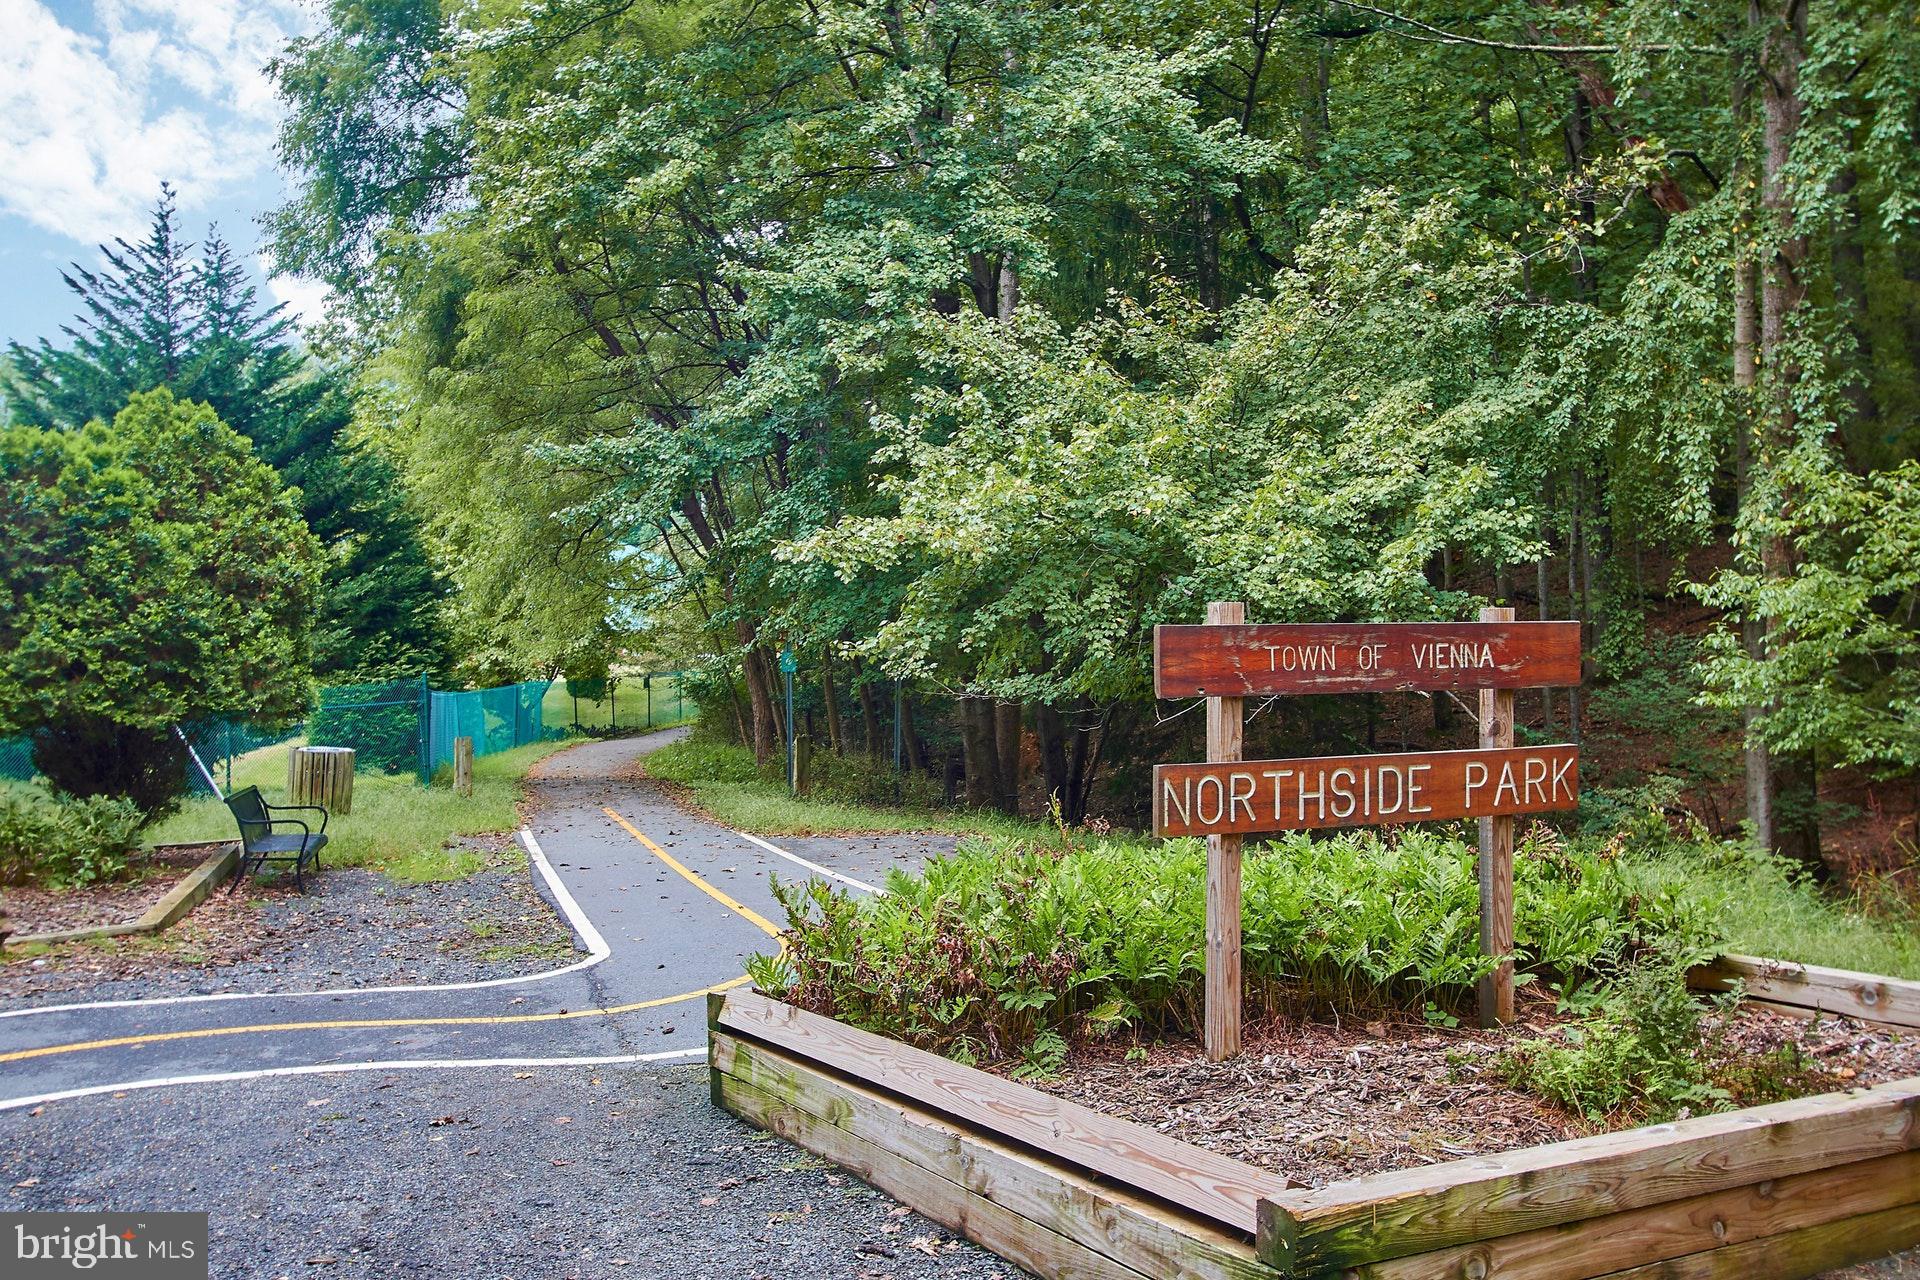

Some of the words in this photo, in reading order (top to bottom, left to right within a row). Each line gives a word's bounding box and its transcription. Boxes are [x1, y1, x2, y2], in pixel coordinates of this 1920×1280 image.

[1264, 645, 1336, 672] TOWN
[1358, 644, 1388, 670] OF
[1411, 643, 1495, 669] VIENNA
[1163, 764, 1433, 828] NORTHSIDE
[1464, 757, 1575, 809] PARK
